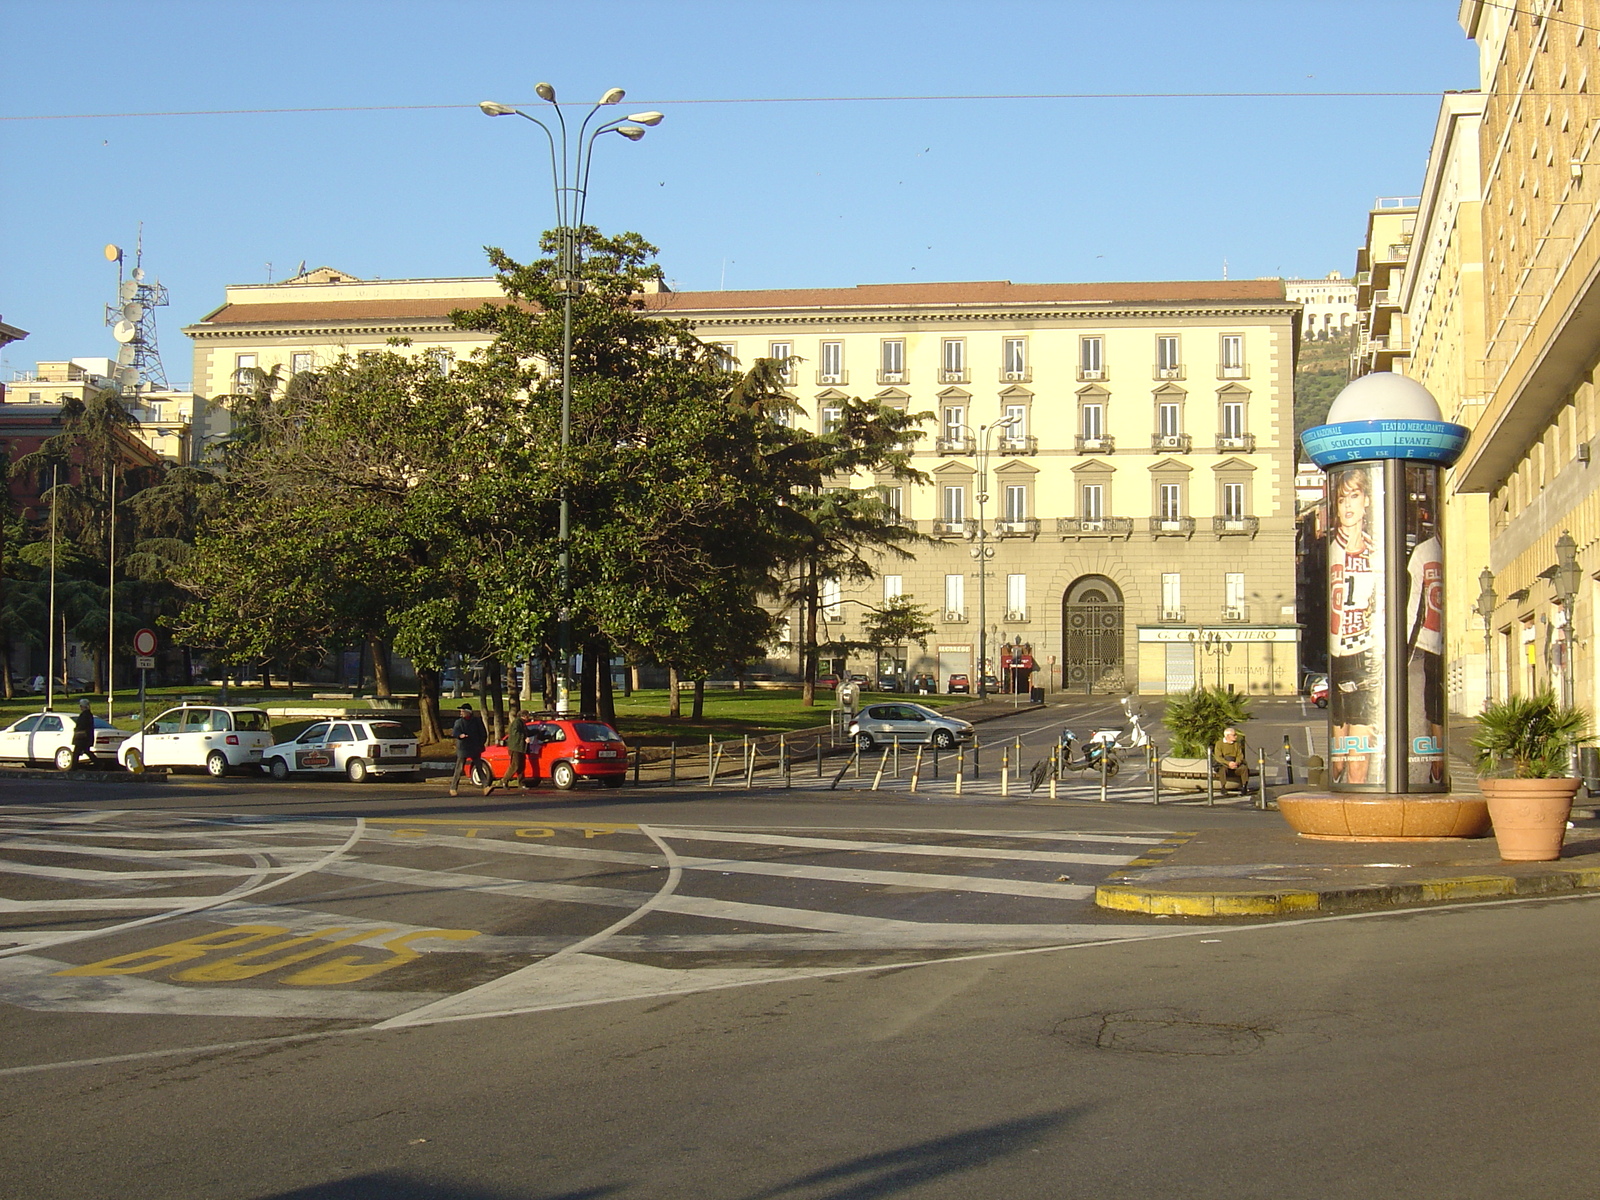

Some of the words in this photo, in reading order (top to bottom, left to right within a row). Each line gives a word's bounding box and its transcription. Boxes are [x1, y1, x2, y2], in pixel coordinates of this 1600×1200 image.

[1381, 422, 1406, 432] TEATRO
[1407, 423, 1445, 433] MERCADANTE
[1330, 437, 1372, 449] SCIROCCO
[1393, 437, 1432, 446] LEVANTE
[1347, 450, 1362, 460] SE
[1406, 449, 1415, 457] E
[1344, 575, 1355, 606] 1
[1157, 630, 1171, 640] G.
[1177, 630, 1277, 640] CRNTIERO
[390, 828, 616, 839] STOP
[49, 924, 482, 986] BUS
